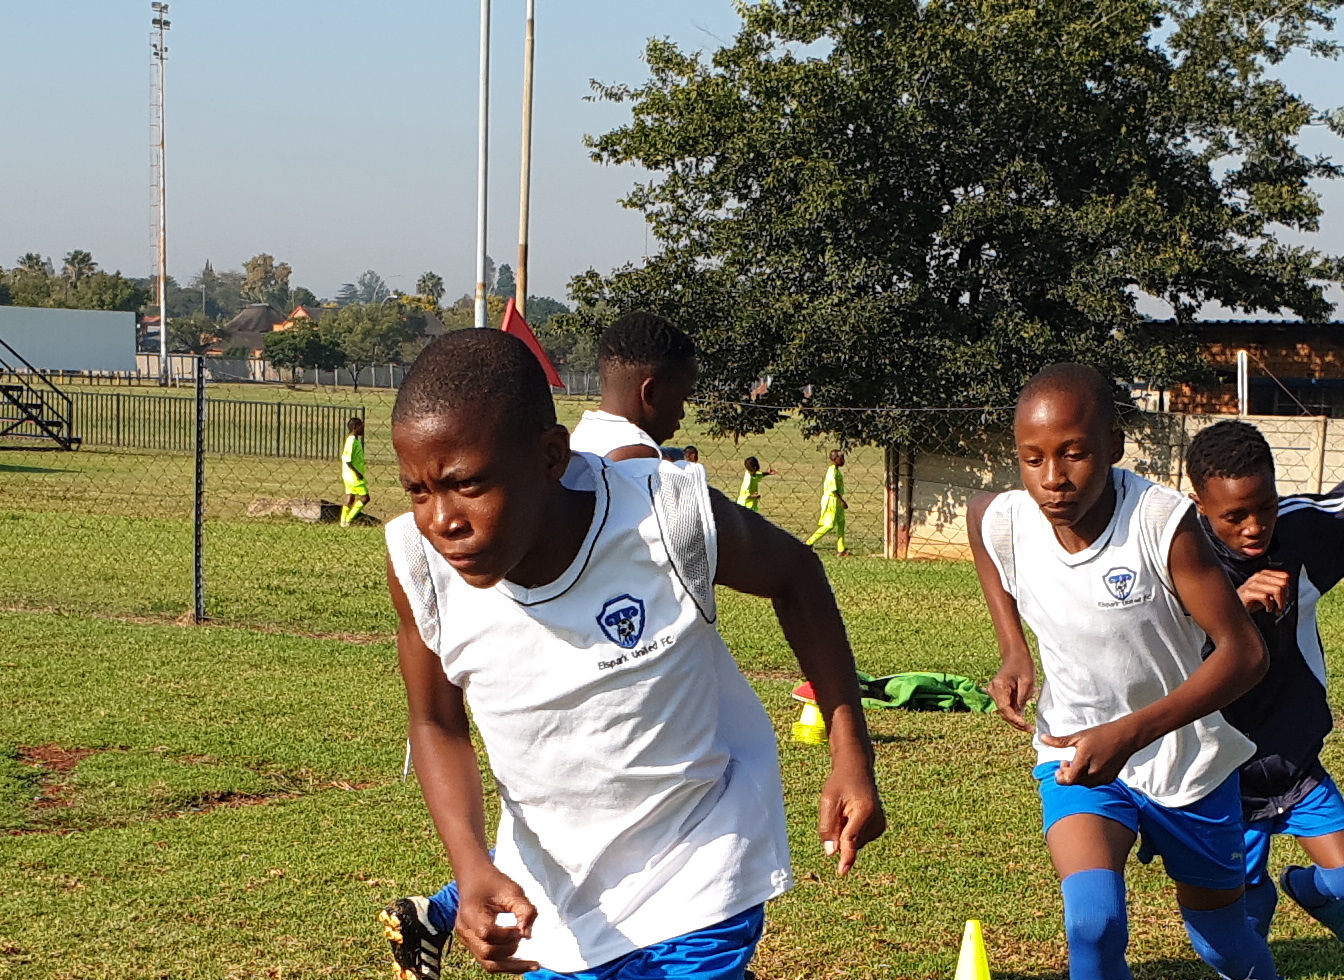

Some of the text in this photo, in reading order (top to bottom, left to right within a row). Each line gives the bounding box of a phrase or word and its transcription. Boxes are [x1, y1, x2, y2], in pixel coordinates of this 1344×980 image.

[598, 635, 673, 670] Elspark United FC
